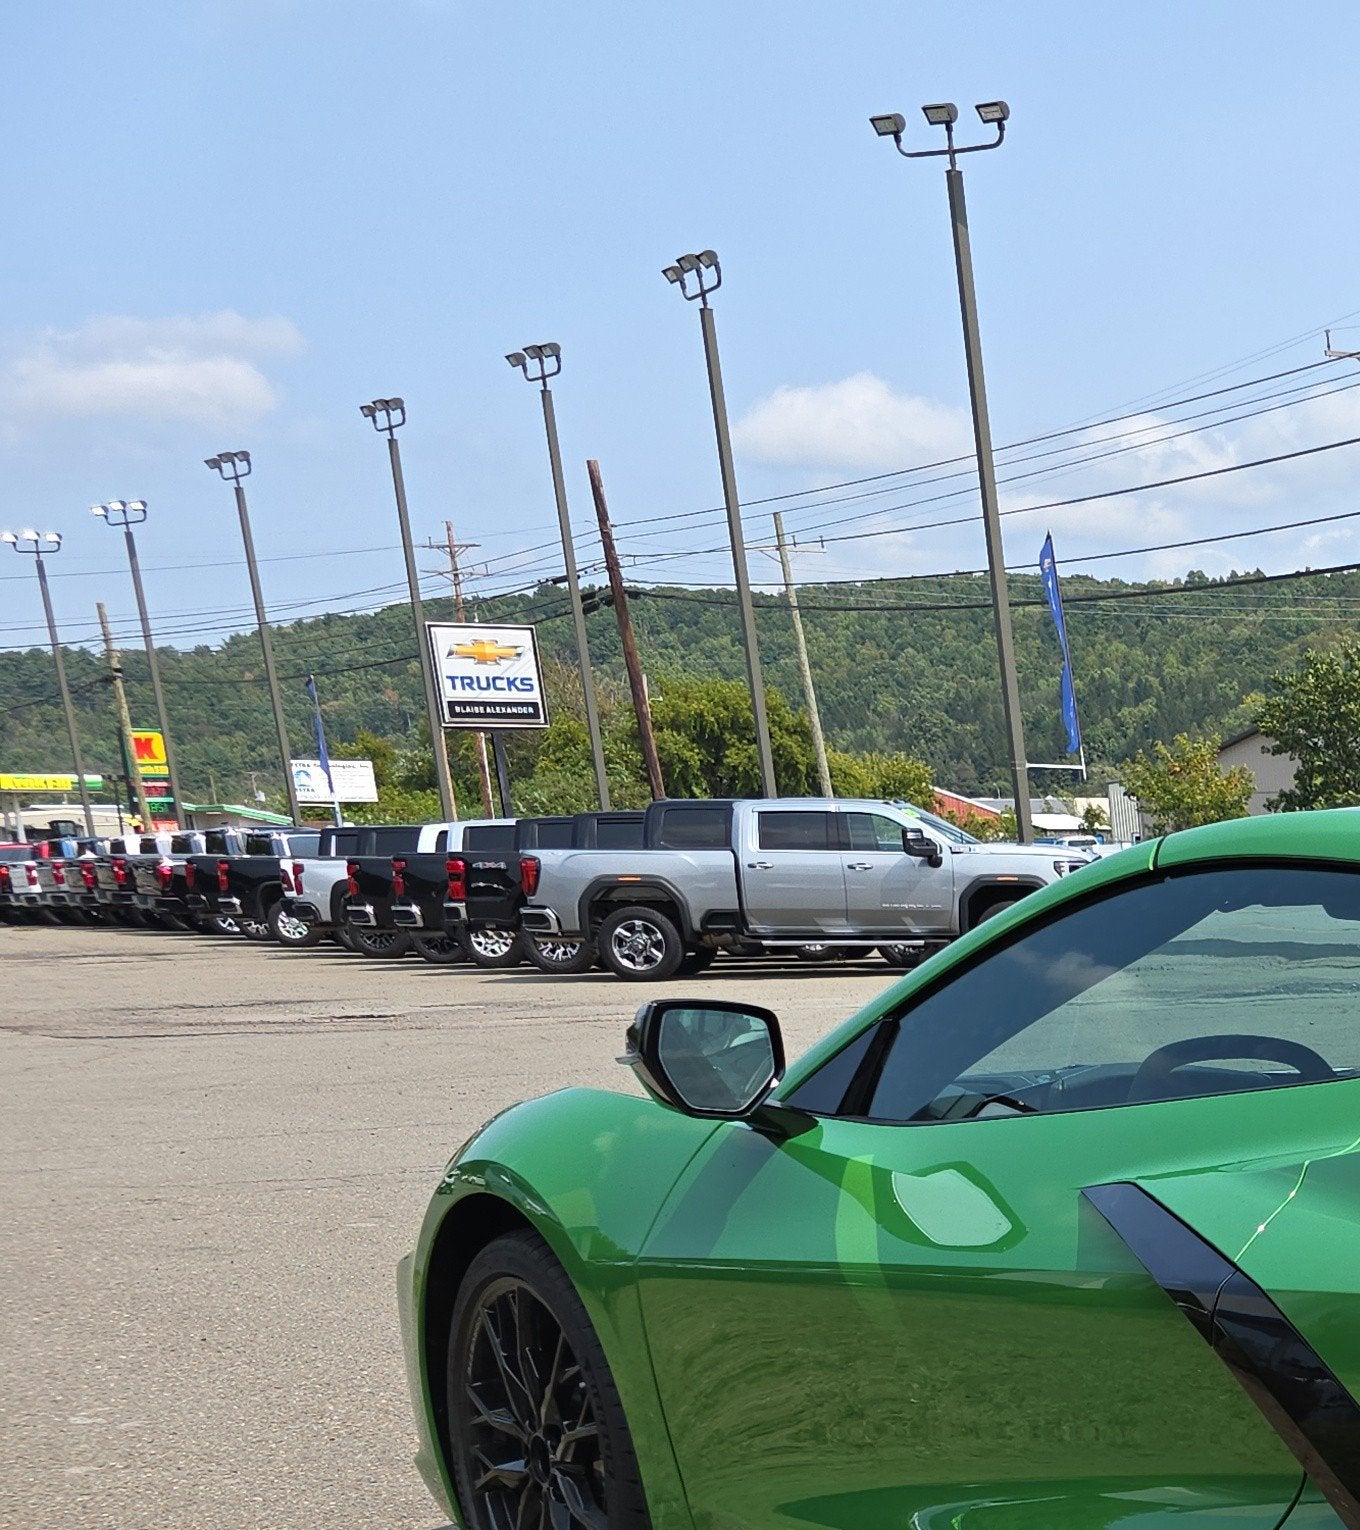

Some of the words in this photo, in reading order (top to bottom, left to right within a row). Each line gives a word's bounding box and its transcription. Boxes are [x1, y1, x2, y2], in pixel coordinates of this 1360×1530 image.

[446, 675, 535, 693] TRUCKS
[454, 705, 485, 714] BLAISE
[486, 705, 534, 715] ALEXANDER
[133, 737, 159, 760] K
